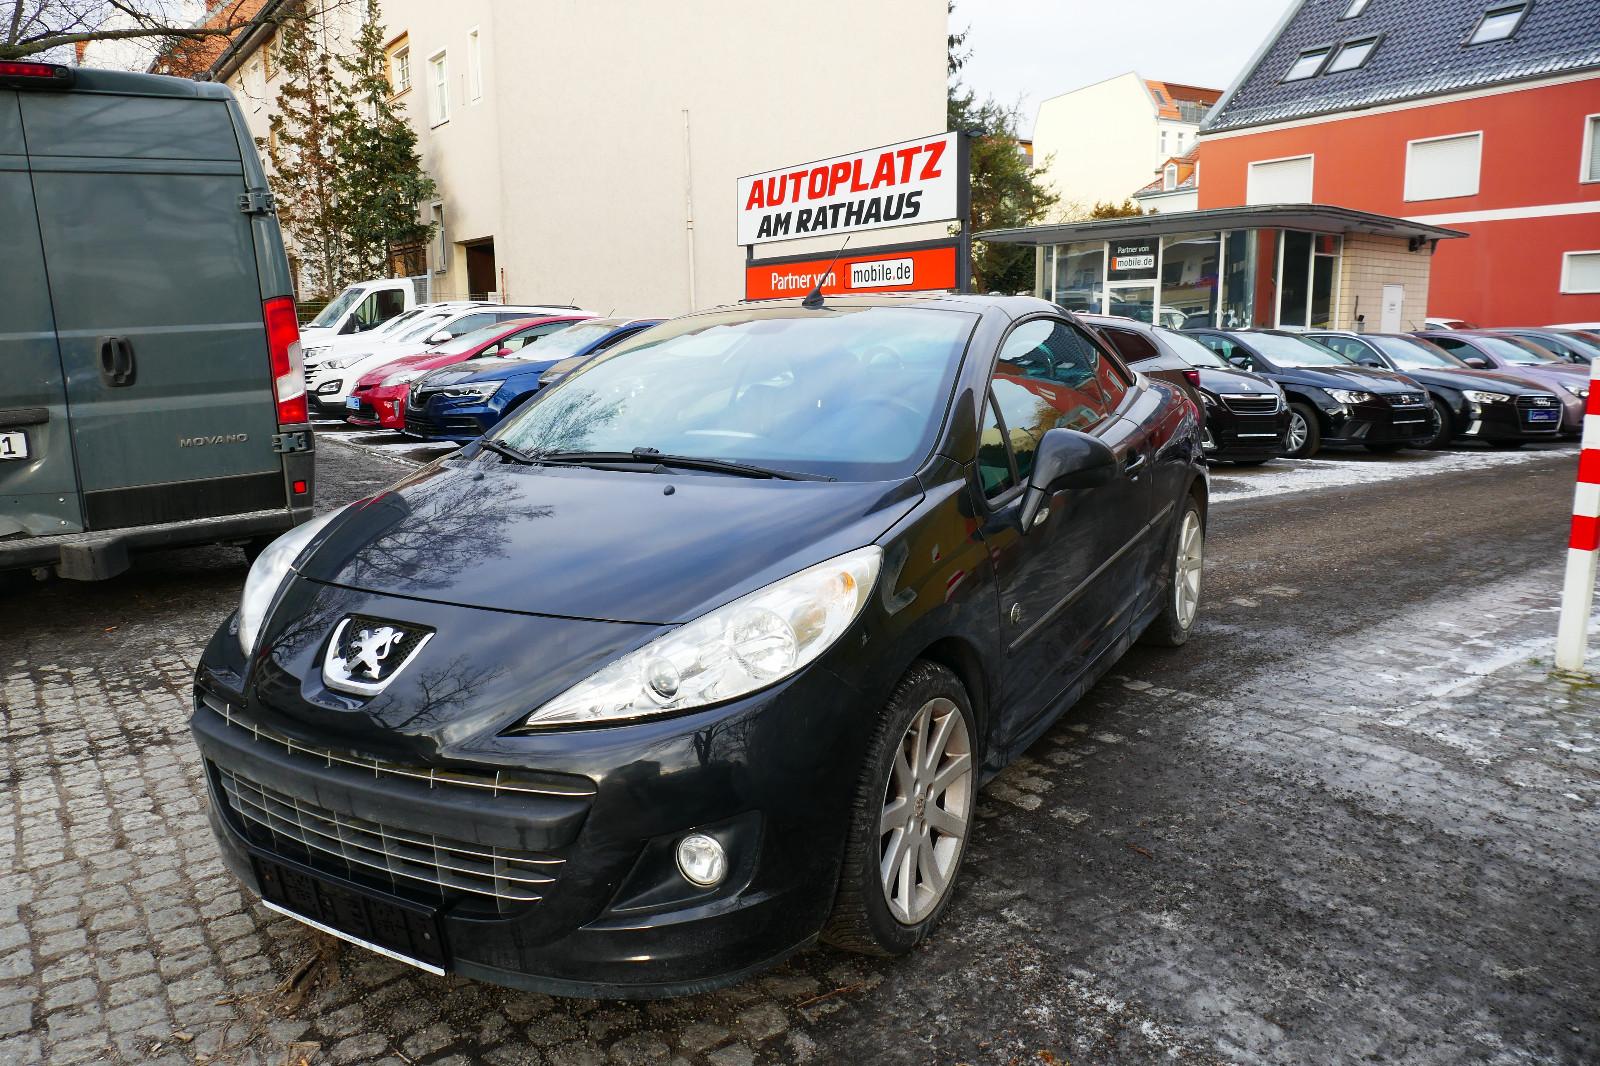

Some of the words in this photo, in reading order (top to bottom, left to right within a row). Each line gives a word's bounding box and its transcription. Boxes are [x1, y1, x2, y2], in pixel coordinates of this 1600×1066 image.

[745, 140, 947, 210] AUTOPLATZ
[756, 211, 792, 239] AM
[795, 190, 923, 234] RATHAUS
[771, 271, 812, 291] Partner
[813, 271, 836, 287] von
[853, 262, 911, 283] mobile.de
[1117, 258, 1152, 267] mobile.de
[180, 433, 248, 448] MOVANO
